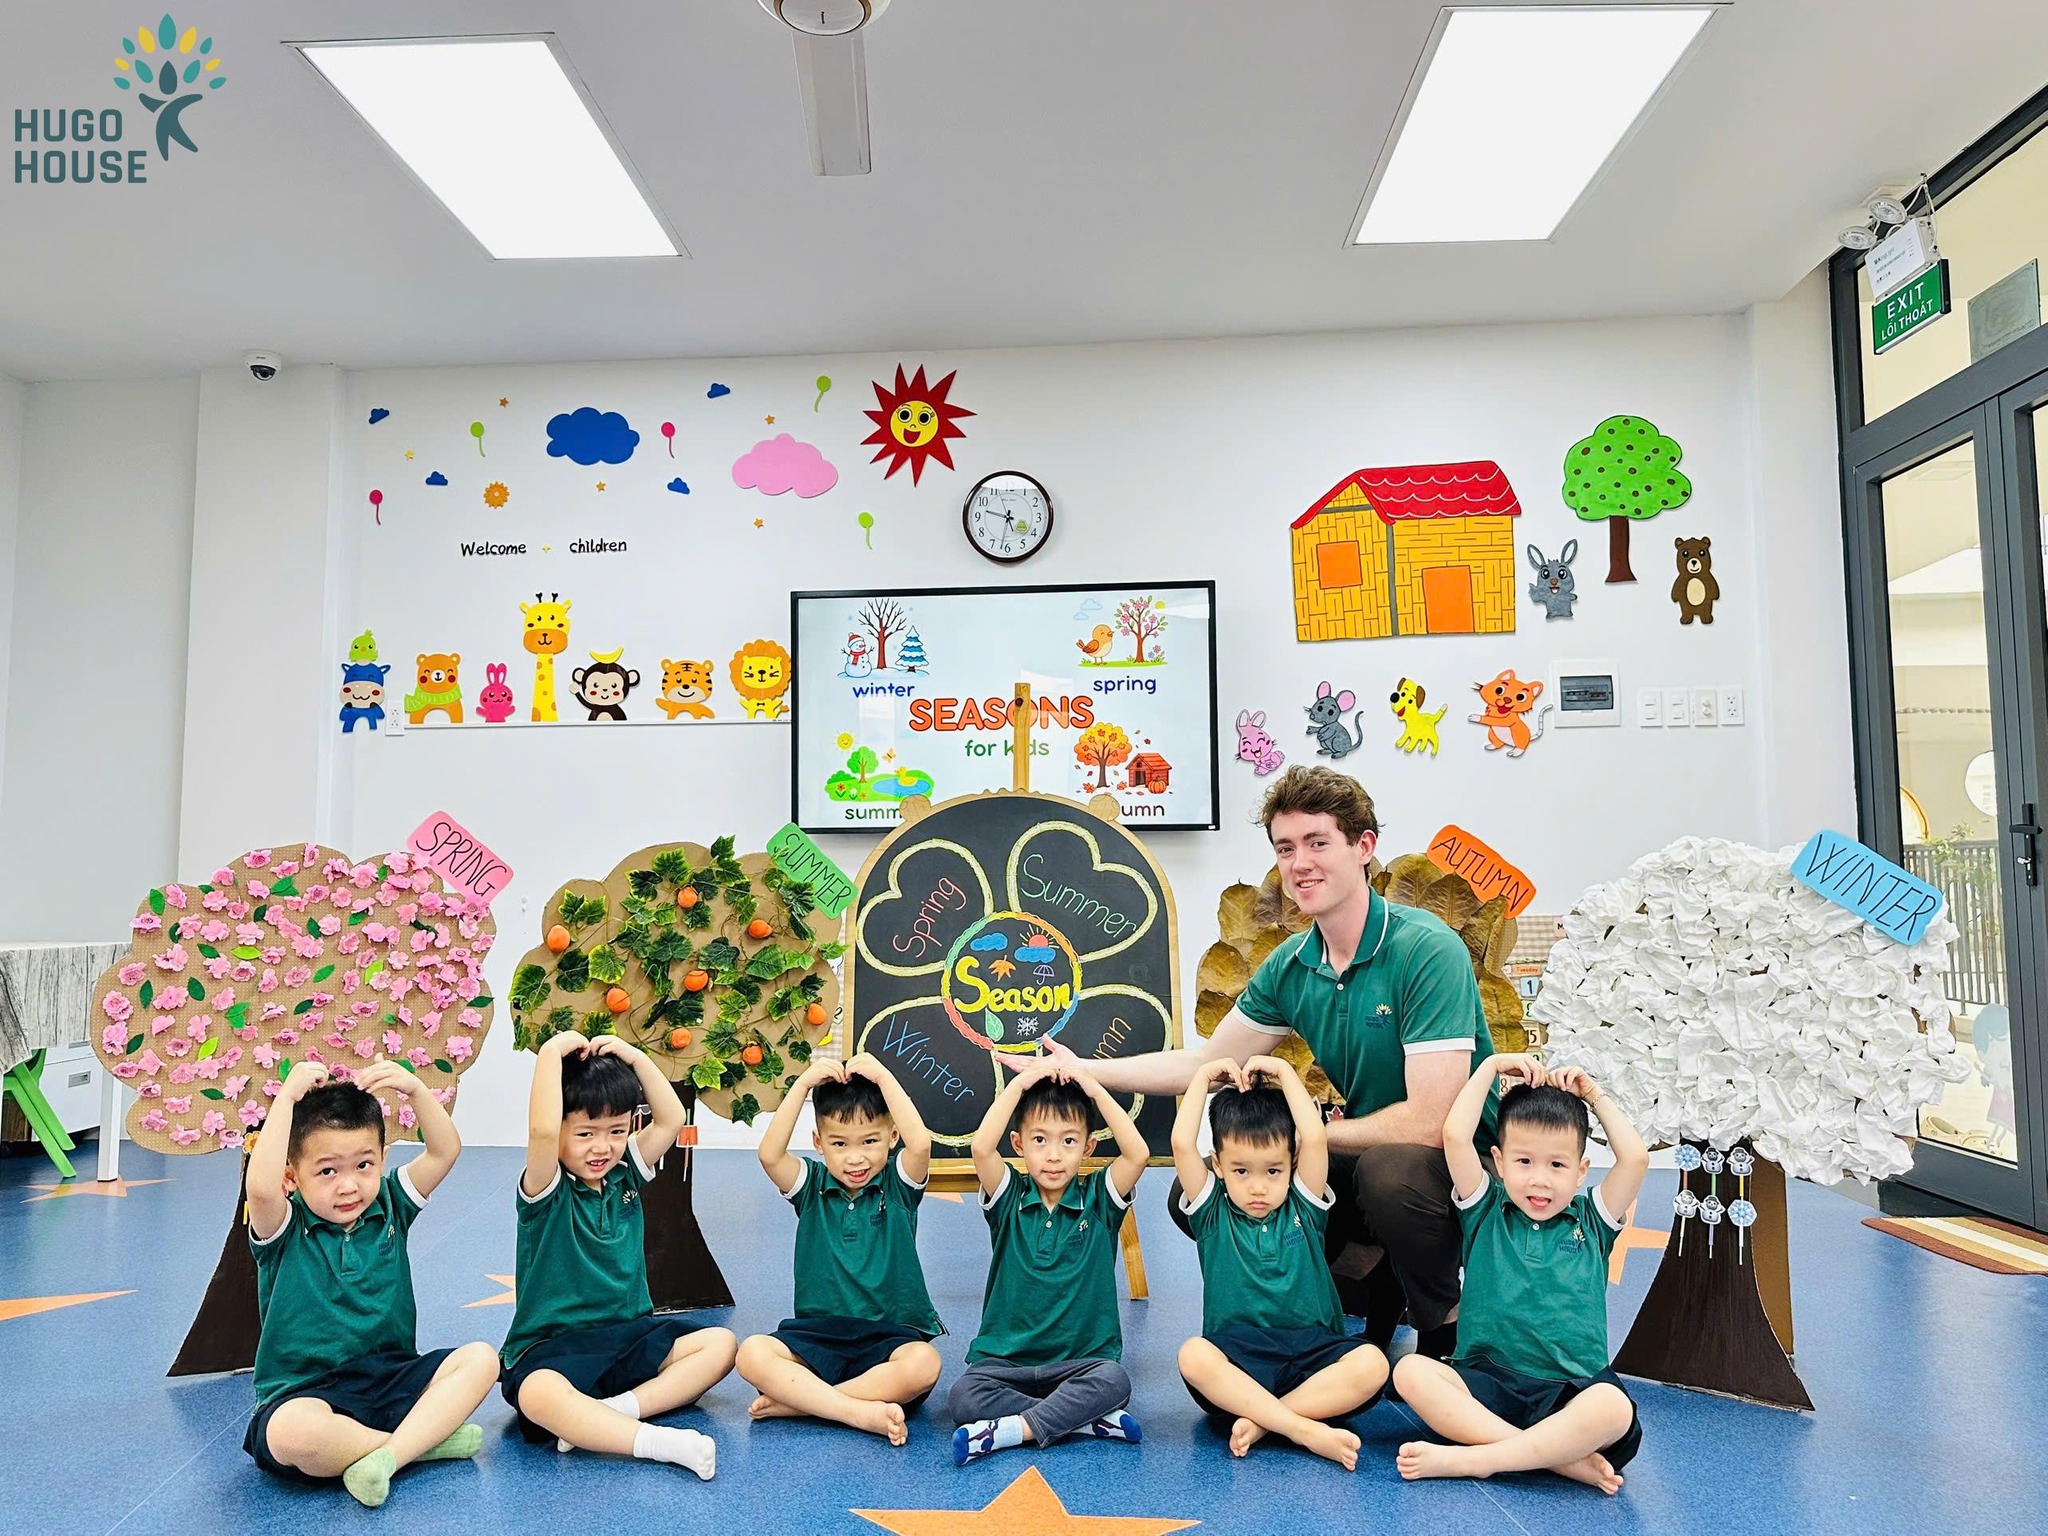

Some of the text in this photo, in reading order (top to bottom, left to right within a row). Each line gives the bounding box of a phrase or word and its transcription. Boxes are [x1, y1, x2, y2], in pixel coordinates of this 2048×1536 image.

[1887, 281, 1924, 320] EXIT
[1898, 298, 1933, 329] THOÁT
[979, 497, 988, 507] 10
[1033, 497, 1038, 507] 2
[975, 512, 981, 522] 9
[1036, 513, 1042, 523] 3
[979, 527, 985, 537] 8
[1031, 528, 1037, 538] 4
[460, 538, 627, 557] Welcome children
[990, 539, 995, 549] 7
[1005, 543, 1011, 553] 6
[1020, 539, 1026, 549] 5
[852, 682, 916, 698] winter
[1093, 675, 1157, 695] spring
[965, 739, 1050, 757] for kds
[844, 808, 903, 820] summ
[1121, 804, 1165, 817] umn
[773, 833, 852, 914] SUMMER
[1430, 836, 1530, 912] AUTUMN
[1021, 853, 1137, 938] Summer
[893, 877, 967, 959] Spring
[953, 956, 1074, 1014] Season
[1526, 979, 1533, 995] 1
[882, 1014, 975, 1102] Winter
